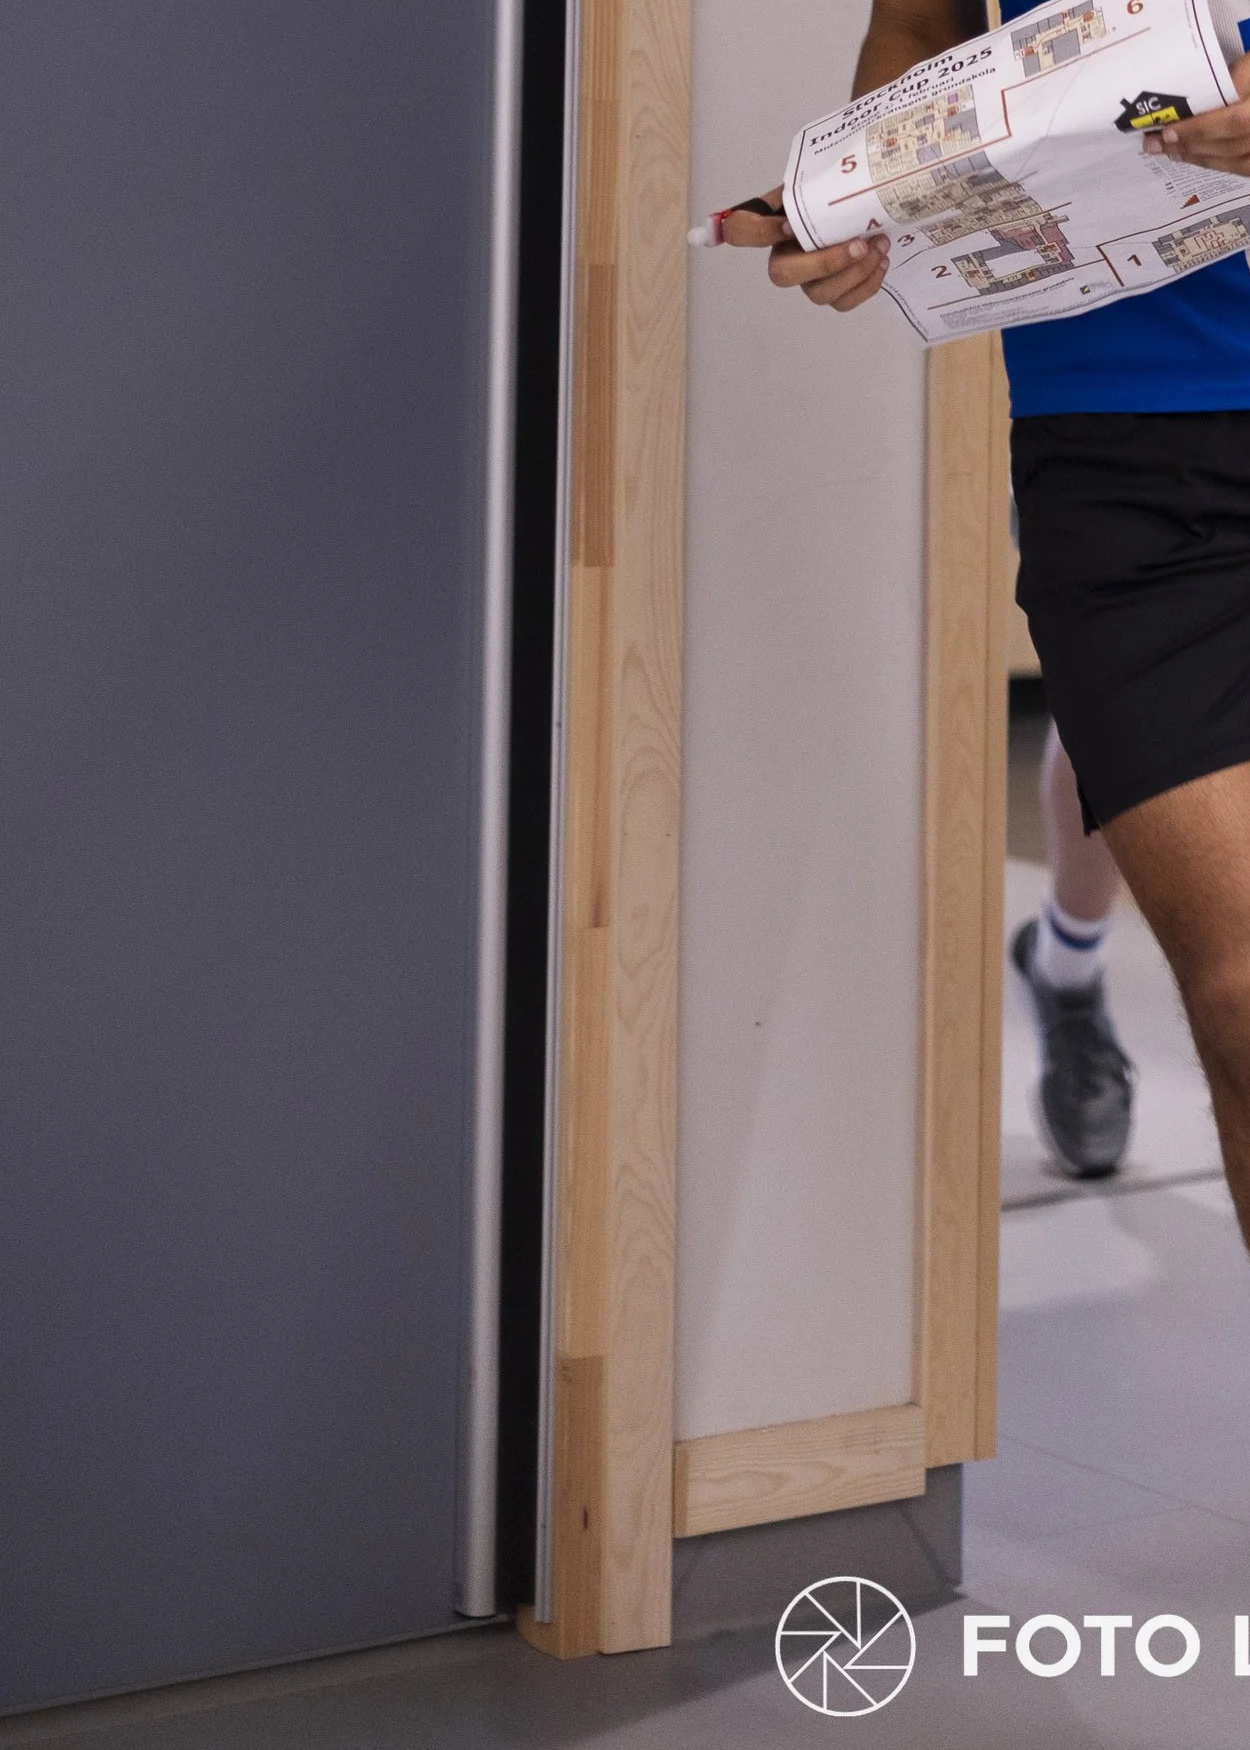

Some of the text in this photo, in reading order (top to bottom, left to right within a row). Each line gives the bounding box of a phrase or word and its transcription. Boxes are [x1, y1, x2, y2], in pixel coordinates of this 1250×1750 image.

[809, 46, 993, 147] Indoor Cup 2025
[1136, 96, 1161, 115] SIC
[841, 154, 857, 174] 5
[897, 234, 916, 248] 3
[1127, 254, 1142, 267] 1
[931, 264, 952, 278] 2
